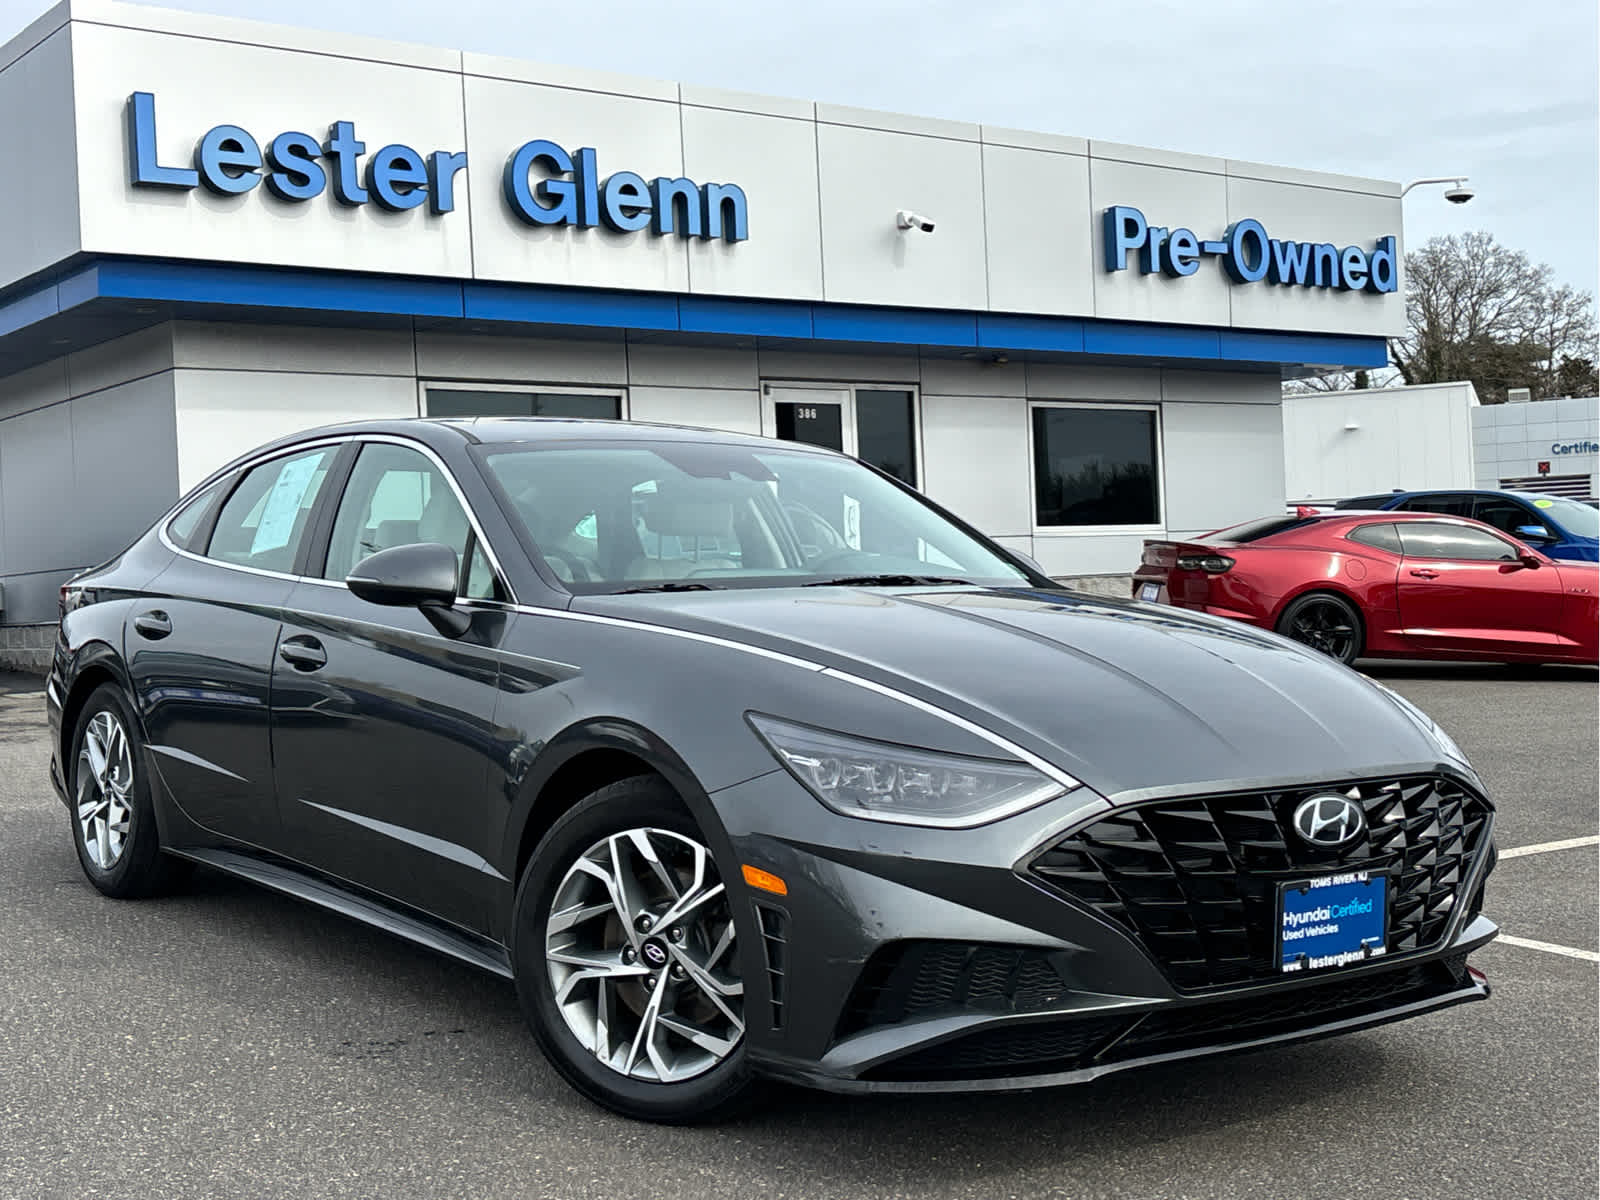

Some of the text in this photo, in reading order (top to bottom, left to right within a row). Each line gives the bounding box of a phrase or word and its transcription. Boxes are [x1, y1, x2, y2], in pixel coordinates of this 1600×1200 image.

[127, 91, 749, 243] Lester Glenn
[1103, 205, 1398, 294] Pre-Owned
[798, 408, 816, 419] 386
[1282, 924, 1338, 941] Used Vehicles
